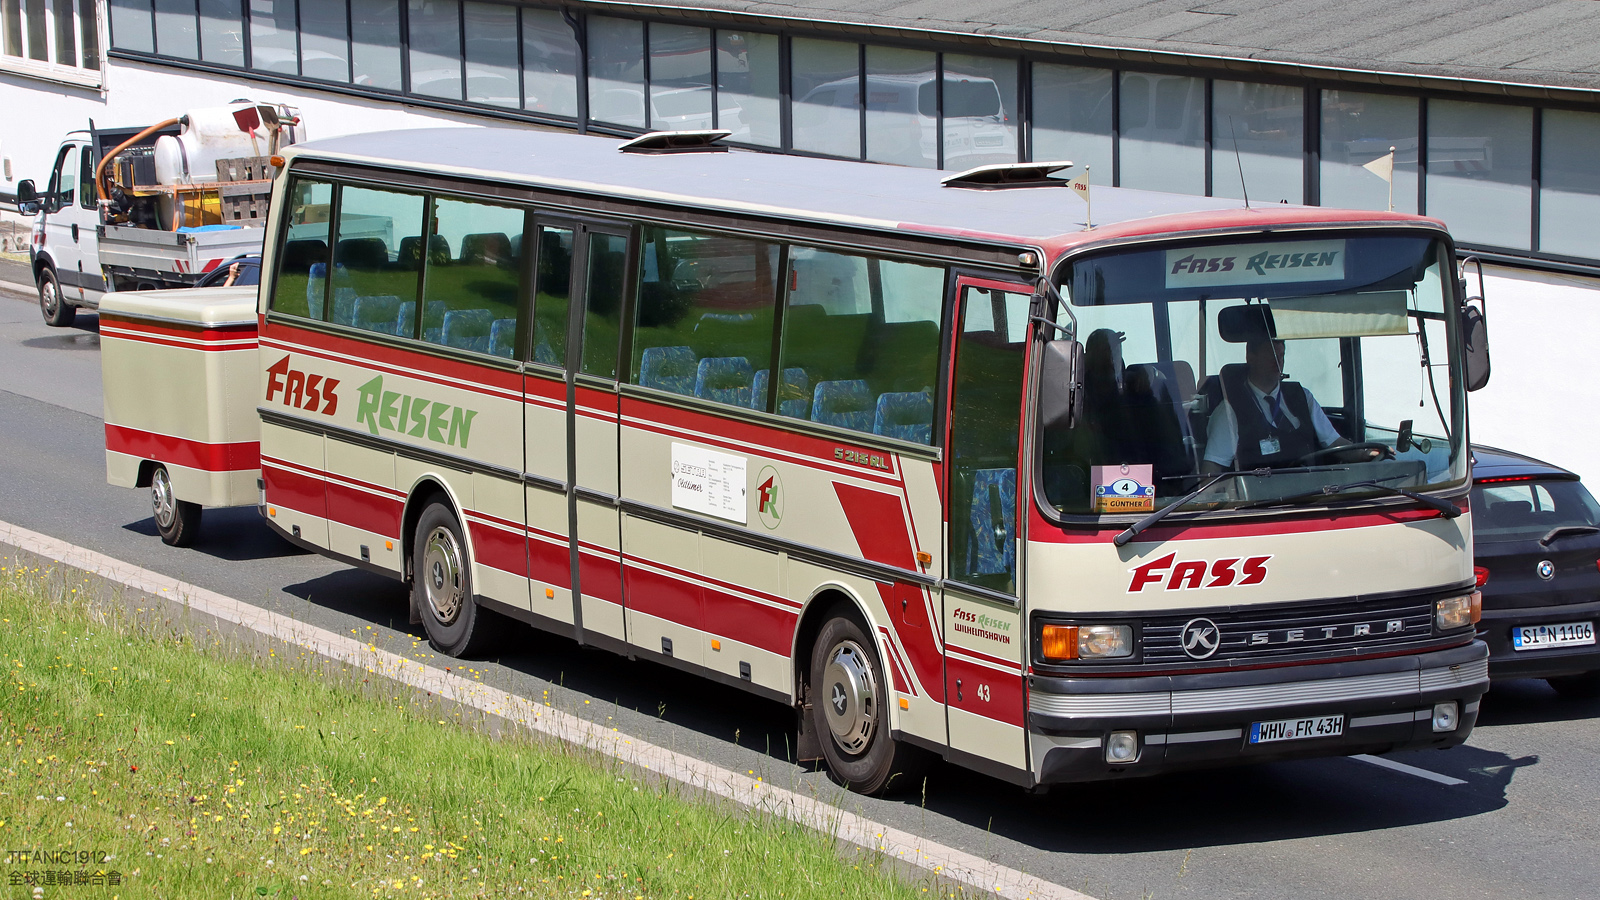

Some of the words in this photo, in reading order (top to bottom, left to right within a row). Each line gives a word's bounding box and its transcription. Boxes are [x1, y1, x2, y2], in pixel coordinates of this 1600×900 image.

[1074, 182, 1087, 191] FASS
[1171, 254, 1237, 275] FASS
[1245, 250, 1340, 276] REISEN
[265, 353, 341, 416] FASS
[356, 374, 479, 449] REISEN
[870, 454, 889, 470] RL
[1121, 482, 1129, 492] 4
[1110, 499, 1143, 508] GÜNTHER
[1126, 550, 1274, 593] FASS
[953, 607, 977, 623] FASS
[977, 613, 1012, 632] REISEN
[954, 622, 1011, 645] WILHELMSHAVEN
[1250, 620, 1406, 646] SETRA
[1522, 628, 1540, 644] SI
[1559, 624, 1592, 641] 1106
[977, 683, 991, 702] 43
[1260, 722, 1287, 740] WHV
[1295, 720, 1314, 737] FR
[1316, 717, 1343, 735] 43H
